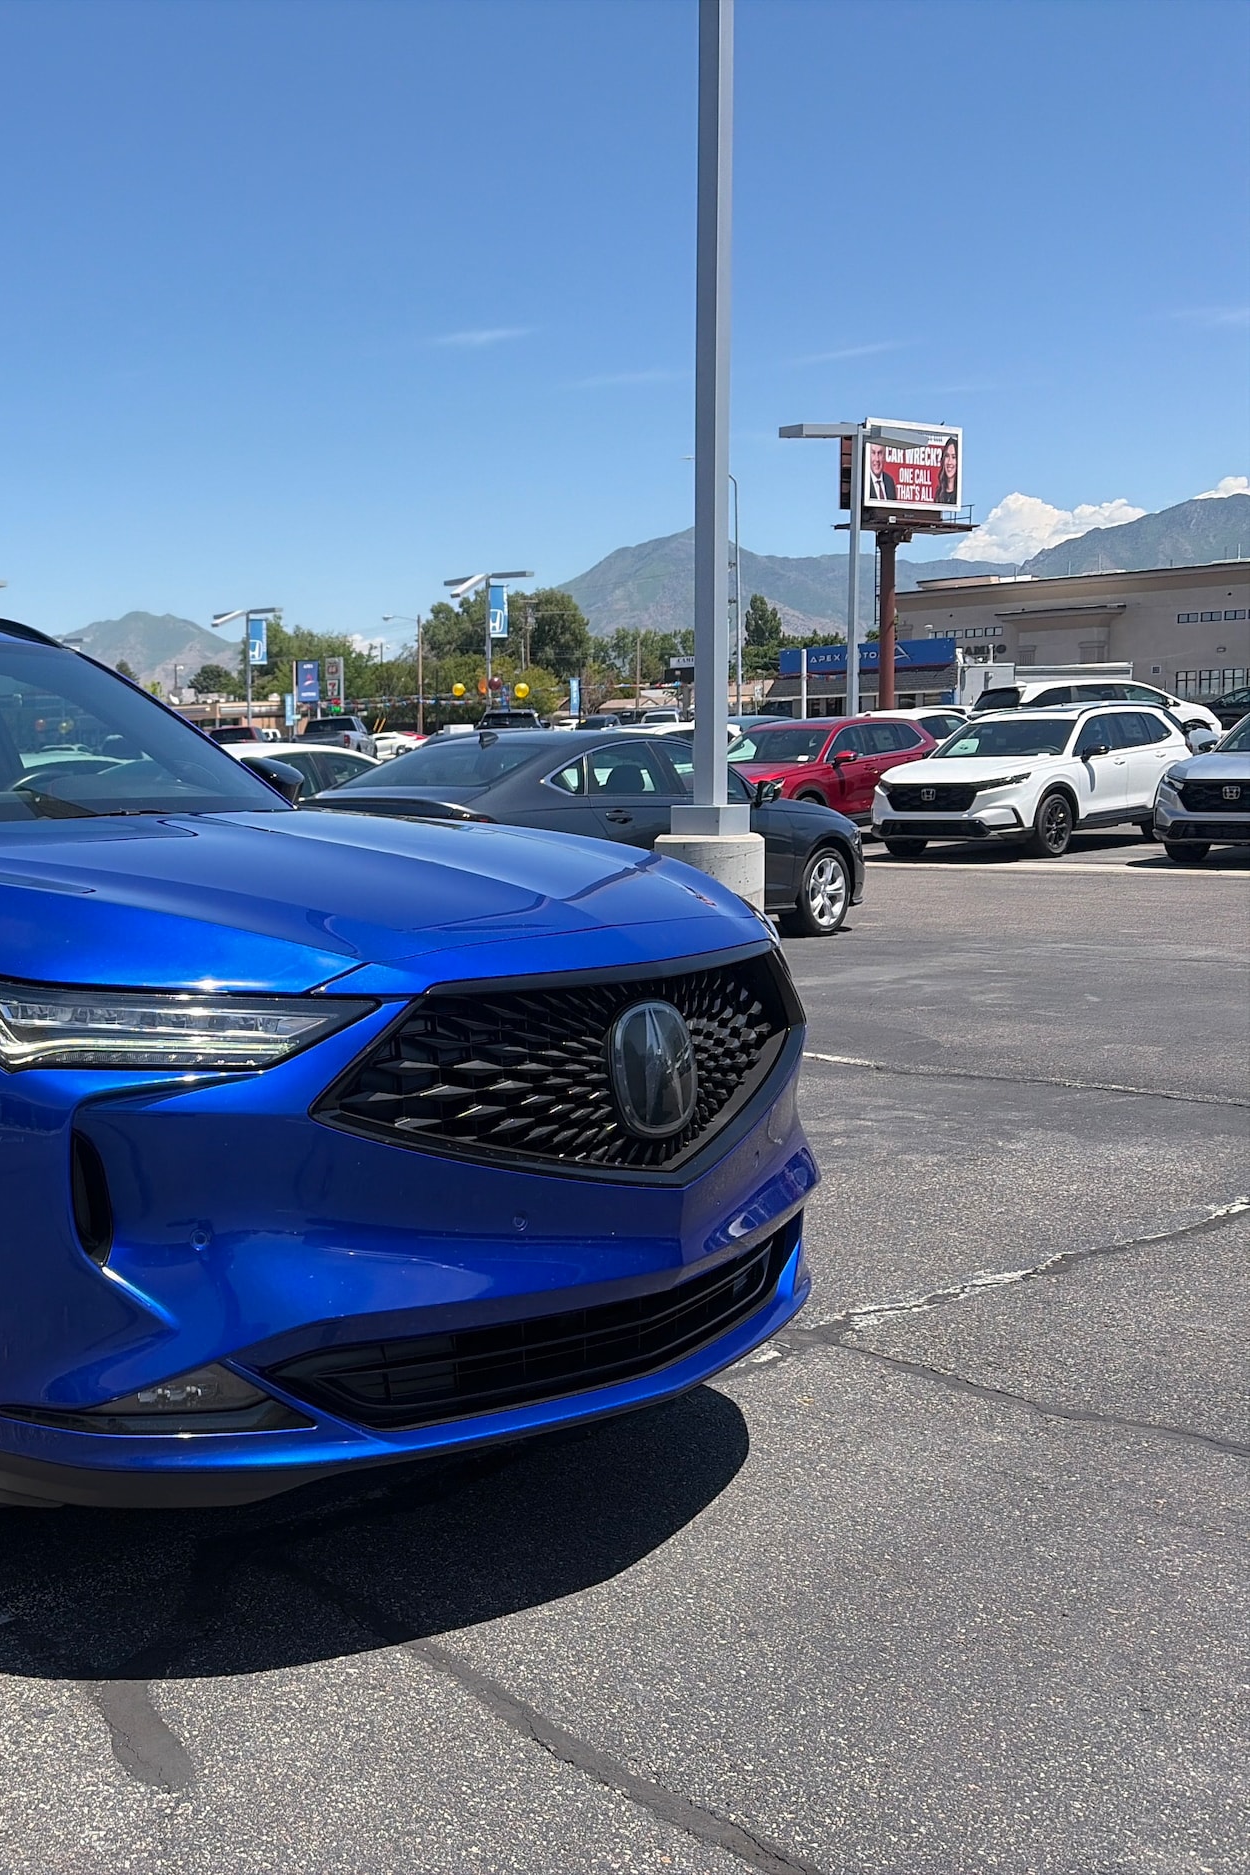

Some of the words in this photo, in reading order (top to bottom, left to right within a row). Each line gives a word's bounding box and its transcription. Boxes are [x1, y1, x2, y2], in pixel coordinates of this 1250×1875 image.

[885, 446, 904, 464] CAR
[905, 446, 943, 467] WRECK?
[899, 467, 914, 484] ONE
[914, 468, 932, 485] CALL
[896, 484, 921, 501] THAT'S
[920, 486, 935, 502] ALL
[810, 653, 841, 664] APEX
